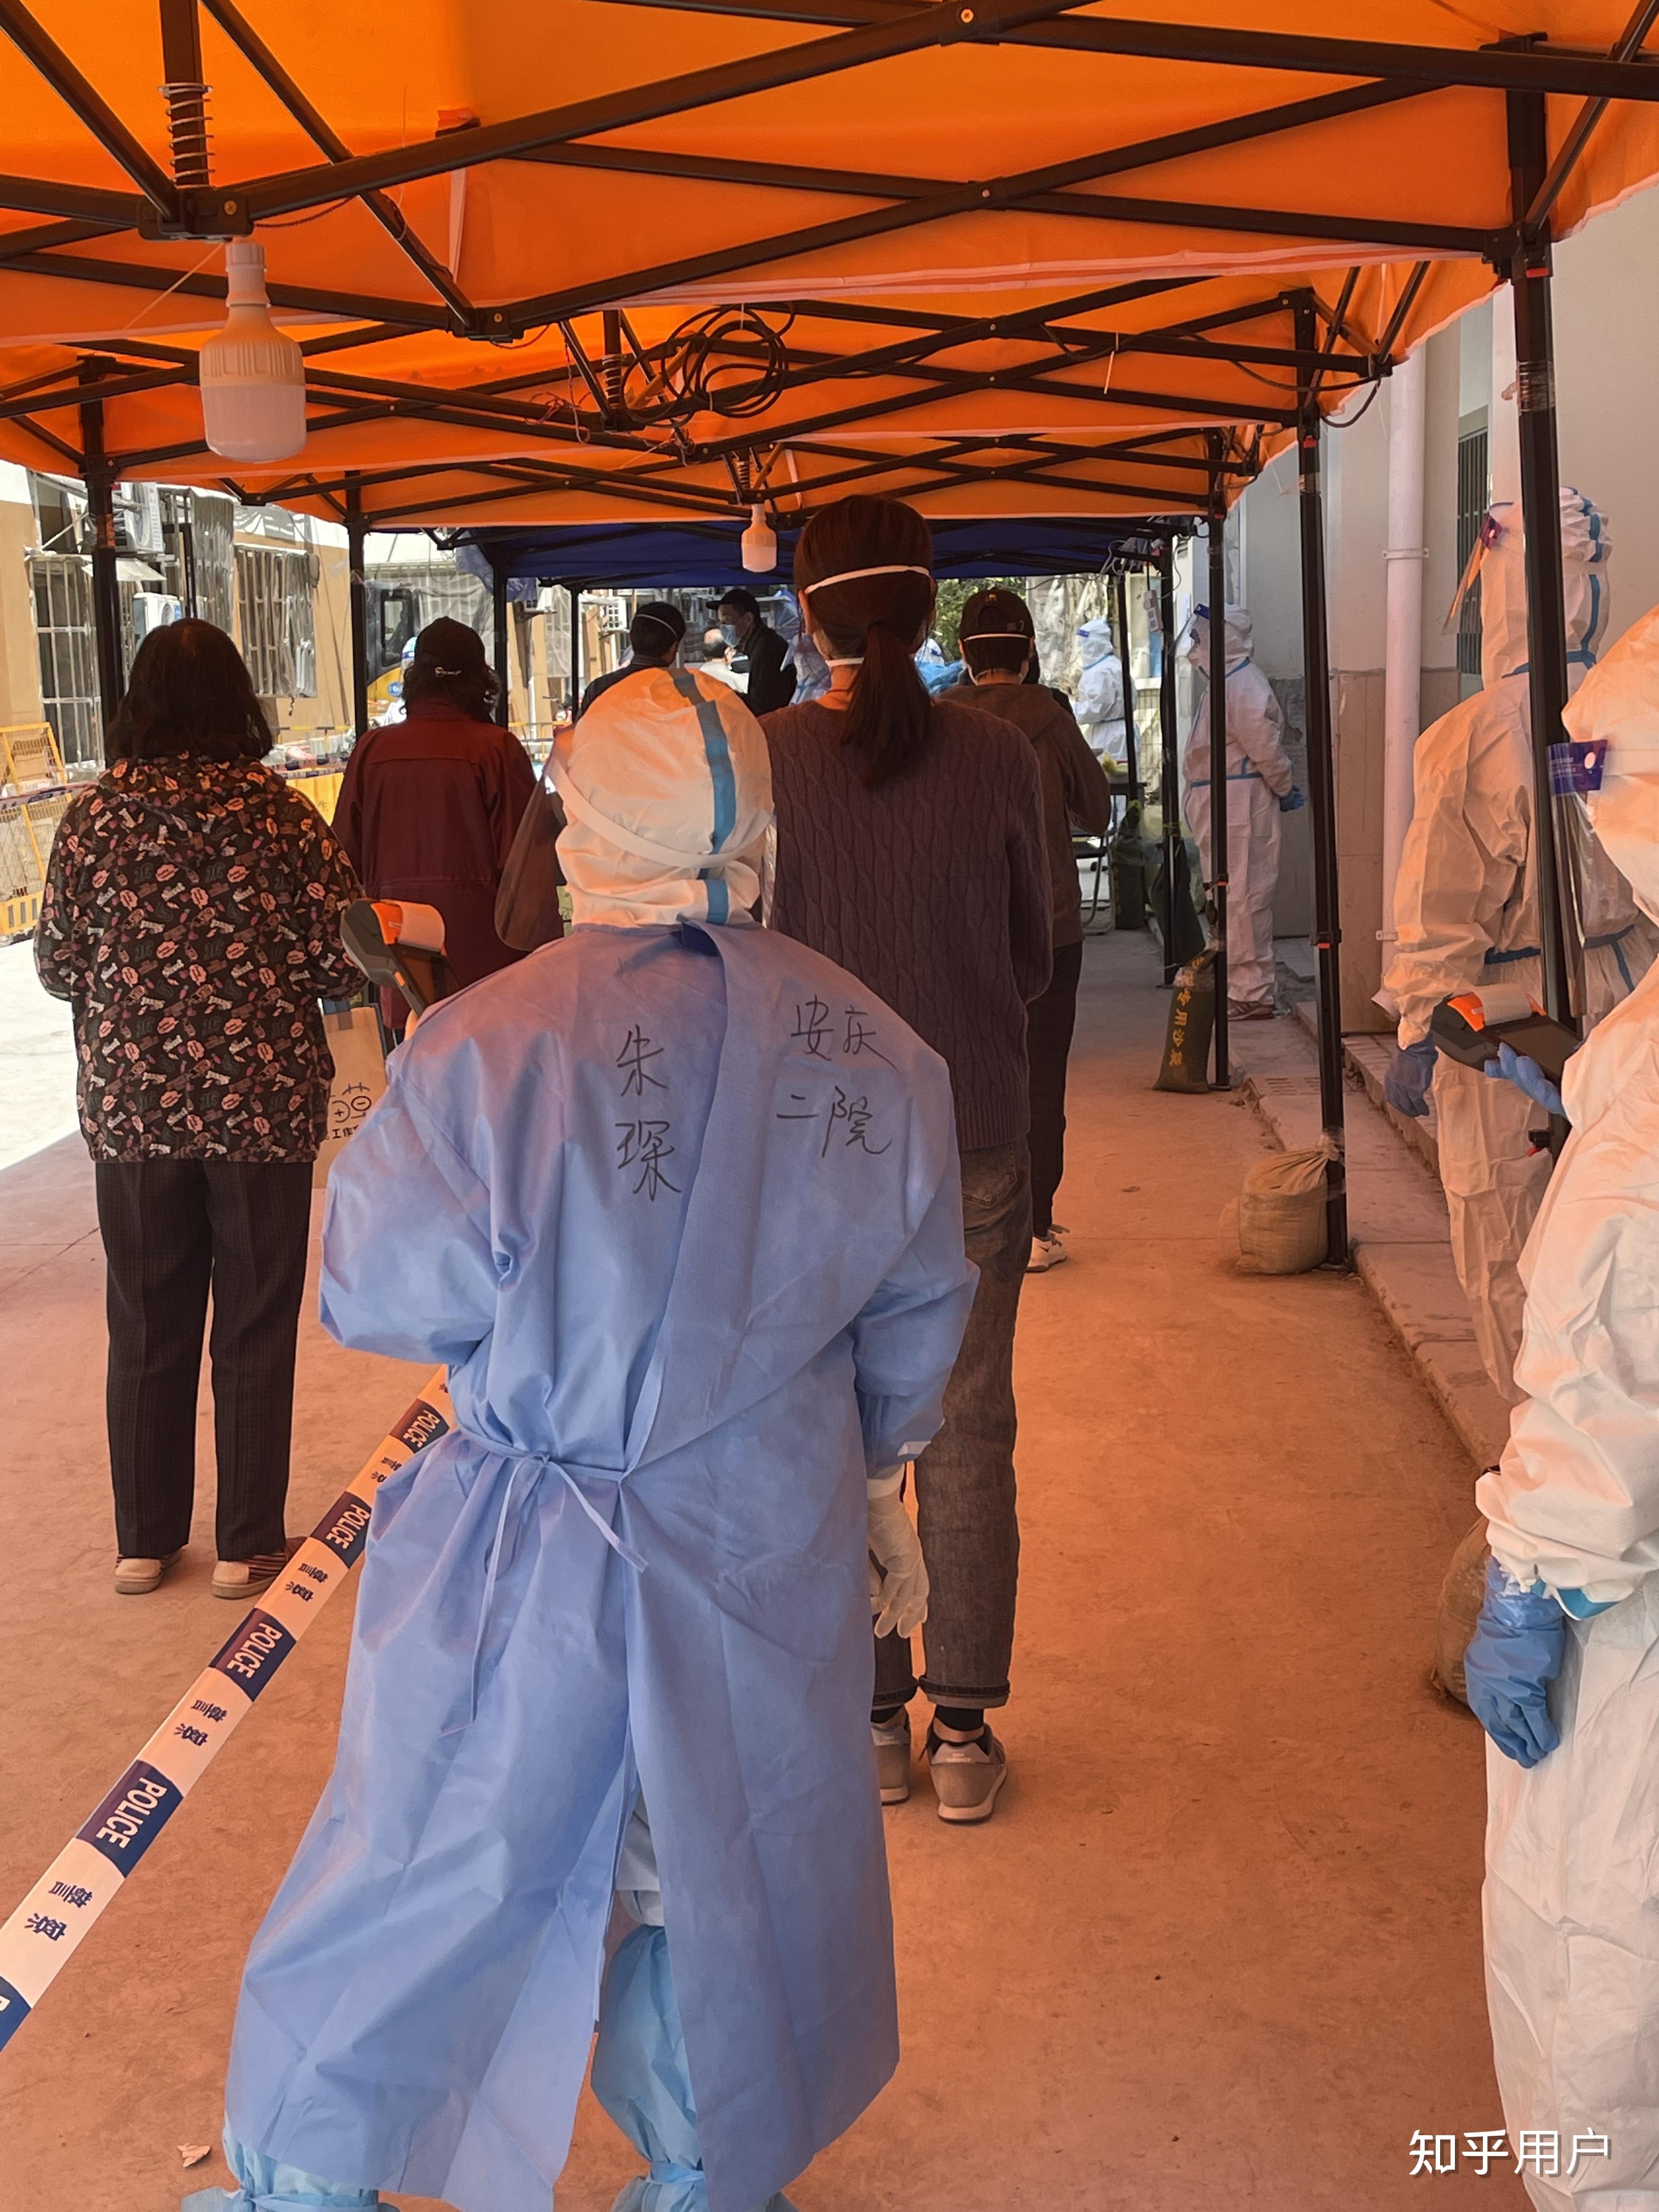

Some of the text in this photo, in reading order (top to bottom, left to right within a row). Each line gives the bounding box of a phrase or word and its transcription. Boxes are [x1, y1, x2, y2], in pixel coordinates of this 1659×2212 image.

[1169, 956, 1205, 1066] 专用沙袋
[777, 1086, 893, 1158] 二院
[403, 1409, 440, 1447] POLICE
[326, 1504, 370, 1549] POLICE
[285, 1563, 328, 1601] 警察
[227, 1623, 283, 1679] POLICE
[173, 1700, 227, 1746] 警察
[96, 1778, 167, 1848] POLICE
[24, 1881, 92, 1941] 警察
